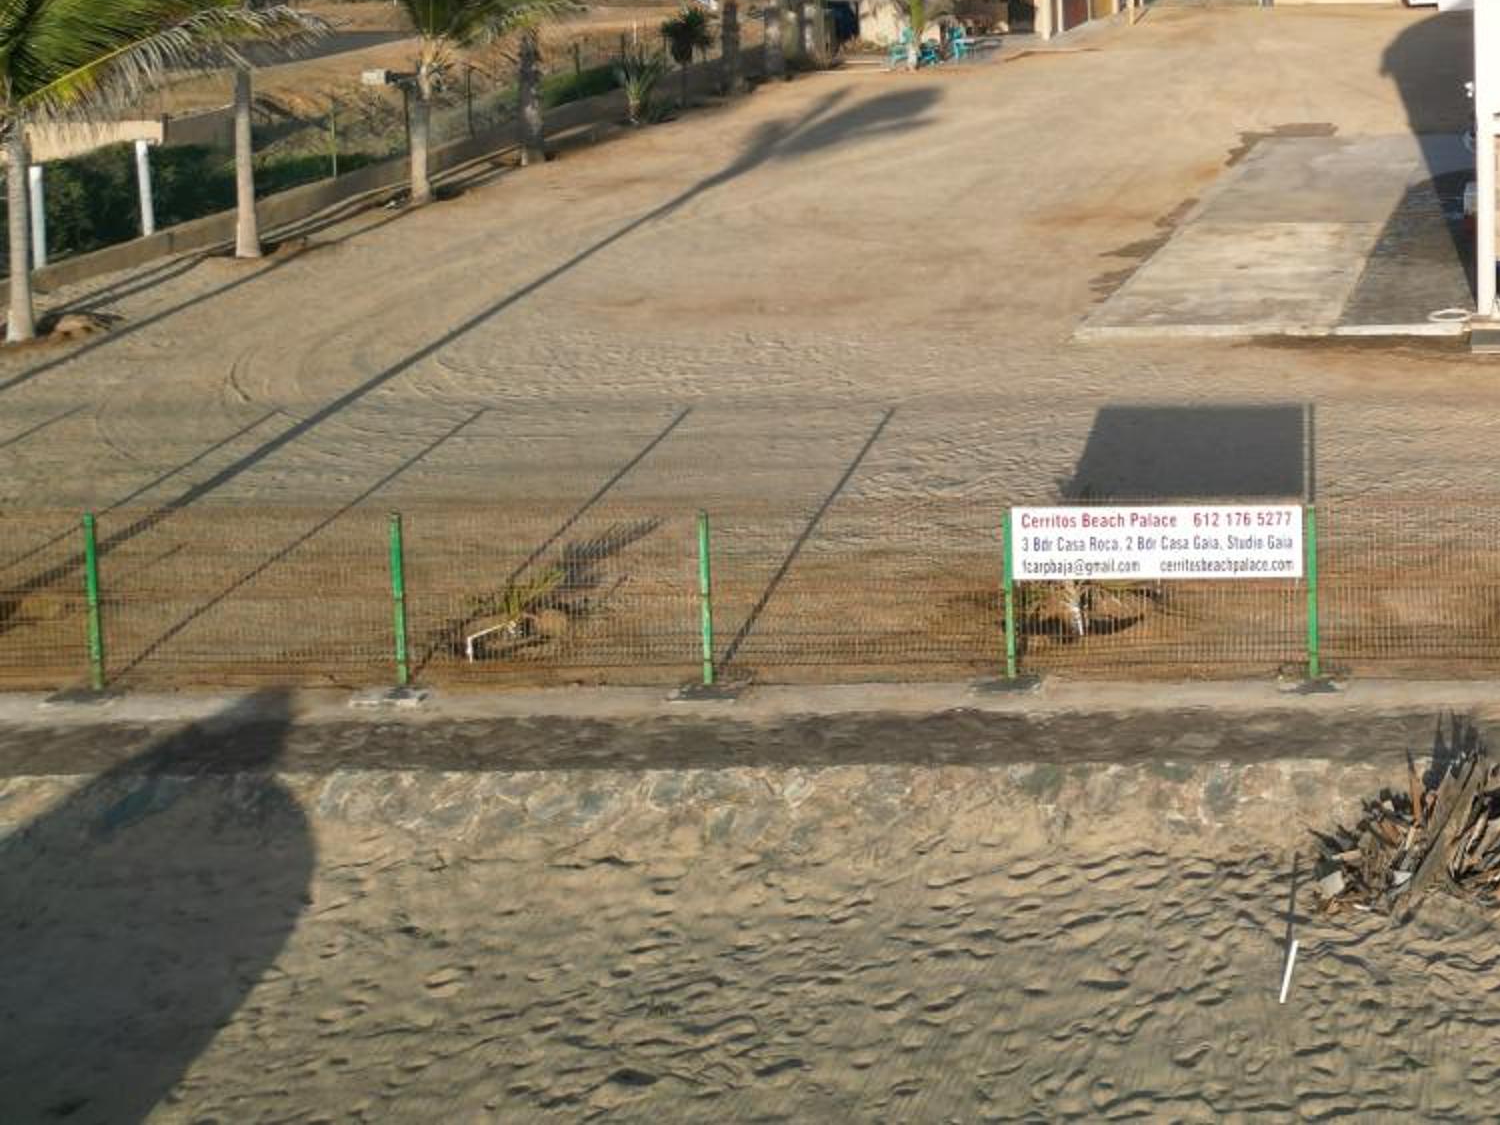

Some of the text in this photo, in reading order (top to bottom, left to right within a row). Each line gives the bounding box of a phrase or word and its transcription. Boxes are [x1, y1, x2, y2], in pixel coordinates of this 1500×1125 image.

[1021, 511, 1292, 528] Cerritos Beach Palace 612 176 5277
[1022, 537, 1029, 552] 3
[1033, 537, 1053, 552] Bdr
[1057, 537, 1086, 552] Casa
[1126, 536, 1133, 550] 2
[1137, 536, 1158, 550] Bdr
[1161, 535, 1189, 550] Casa
[1227, 534, 1264, 549] Studio
[1267, 534, 1294, 549] Gaia
